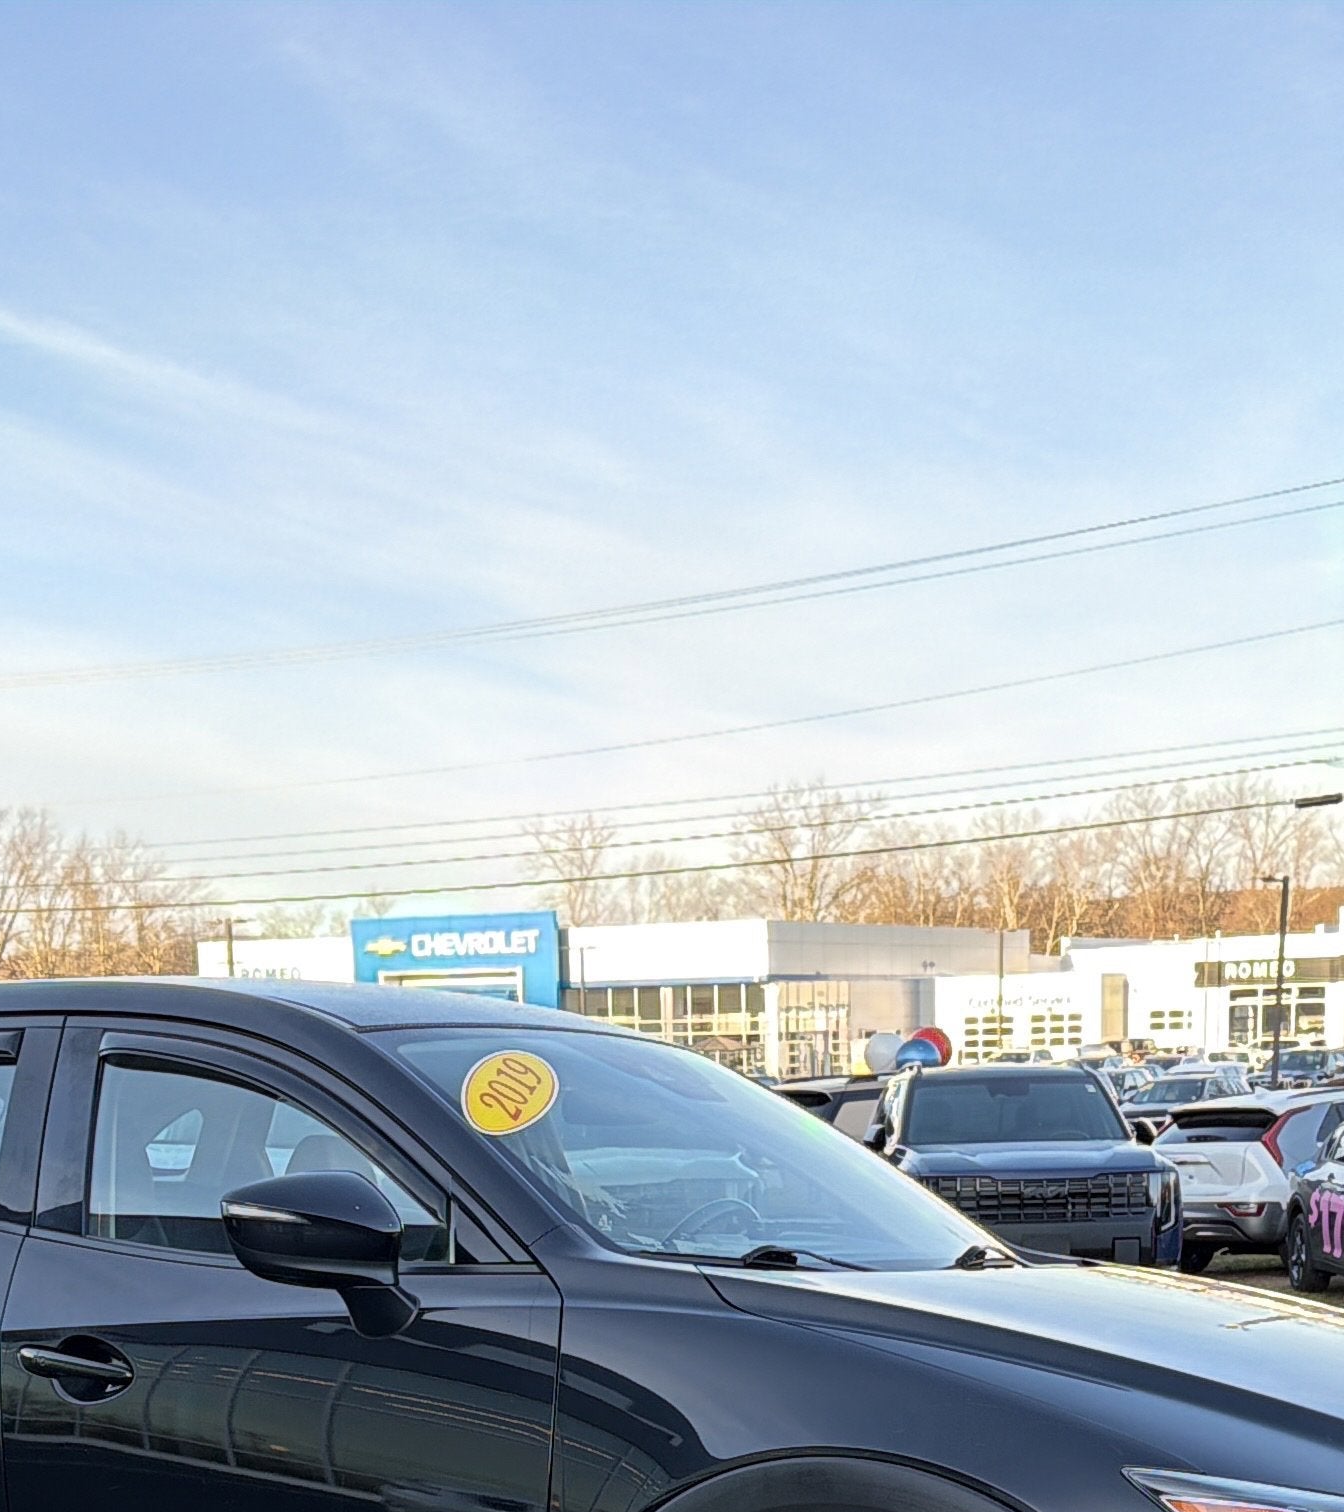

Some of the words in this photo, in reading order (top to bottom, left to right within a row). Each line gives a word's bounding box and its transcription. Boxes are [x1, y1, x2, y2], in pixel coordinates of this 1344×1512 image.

[411, 929, 540, 957] CHEVROLET
[1224, 961, 1296, 981] ROMEO
[479, 1057, 543, 1122] 2019
